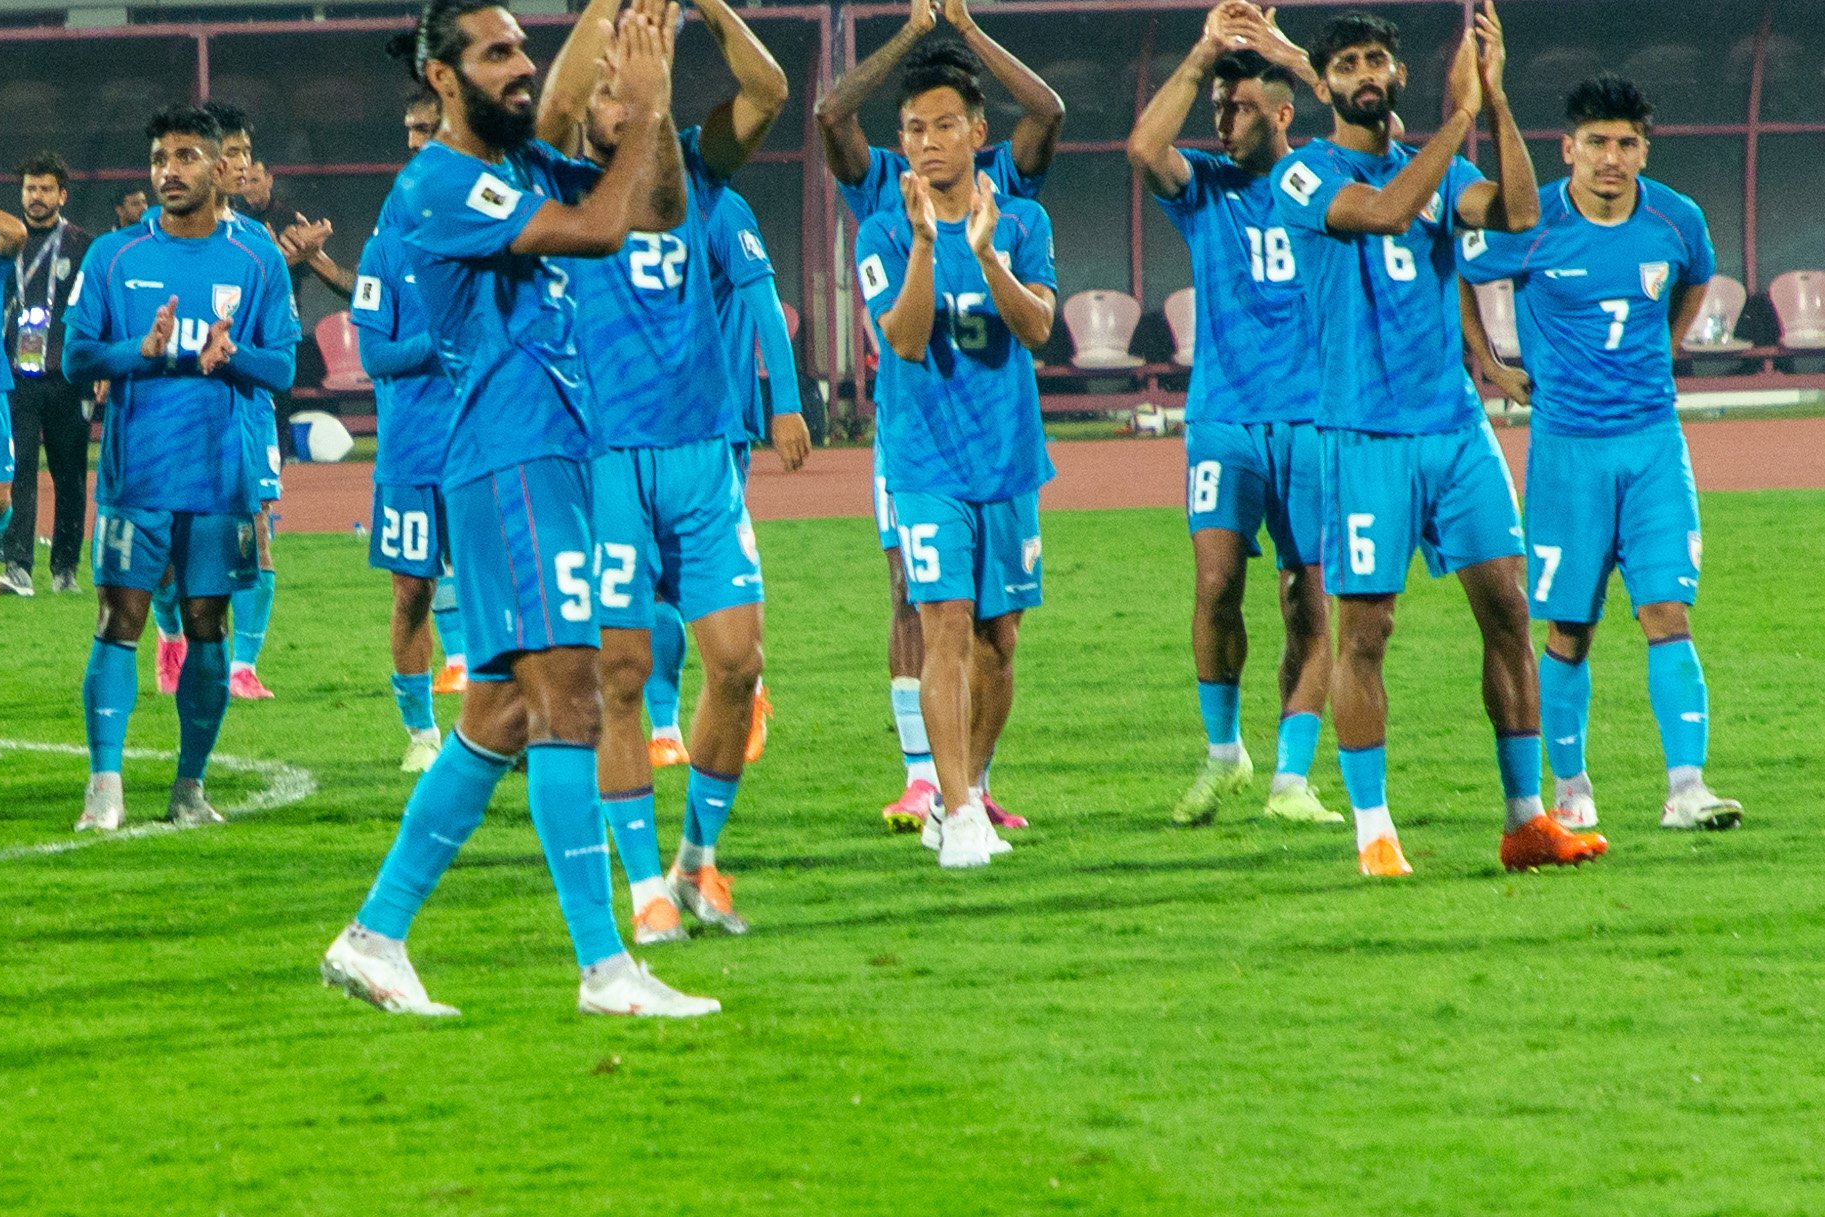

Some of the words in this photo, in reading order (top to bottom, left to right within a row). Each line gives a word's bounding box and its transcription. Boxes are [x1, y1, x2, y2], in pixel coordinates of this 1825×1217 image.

[629, 231, 687, 291] 22
[1245, 226, 1296, 283] 18
[1382, 234, 1417, 282] 6
[942, 291, 988, 350] 15
[1599, 298, 1630, 350] 7
[97, 515, 135, 571] 14
[381, 506, 429, 561] 20
[898, 523, 941, 583] 15
[1347, 513, 1376, 575] 6
[555, 550, 592, 622] 5
[1533, 544, 1562, 602] 7
